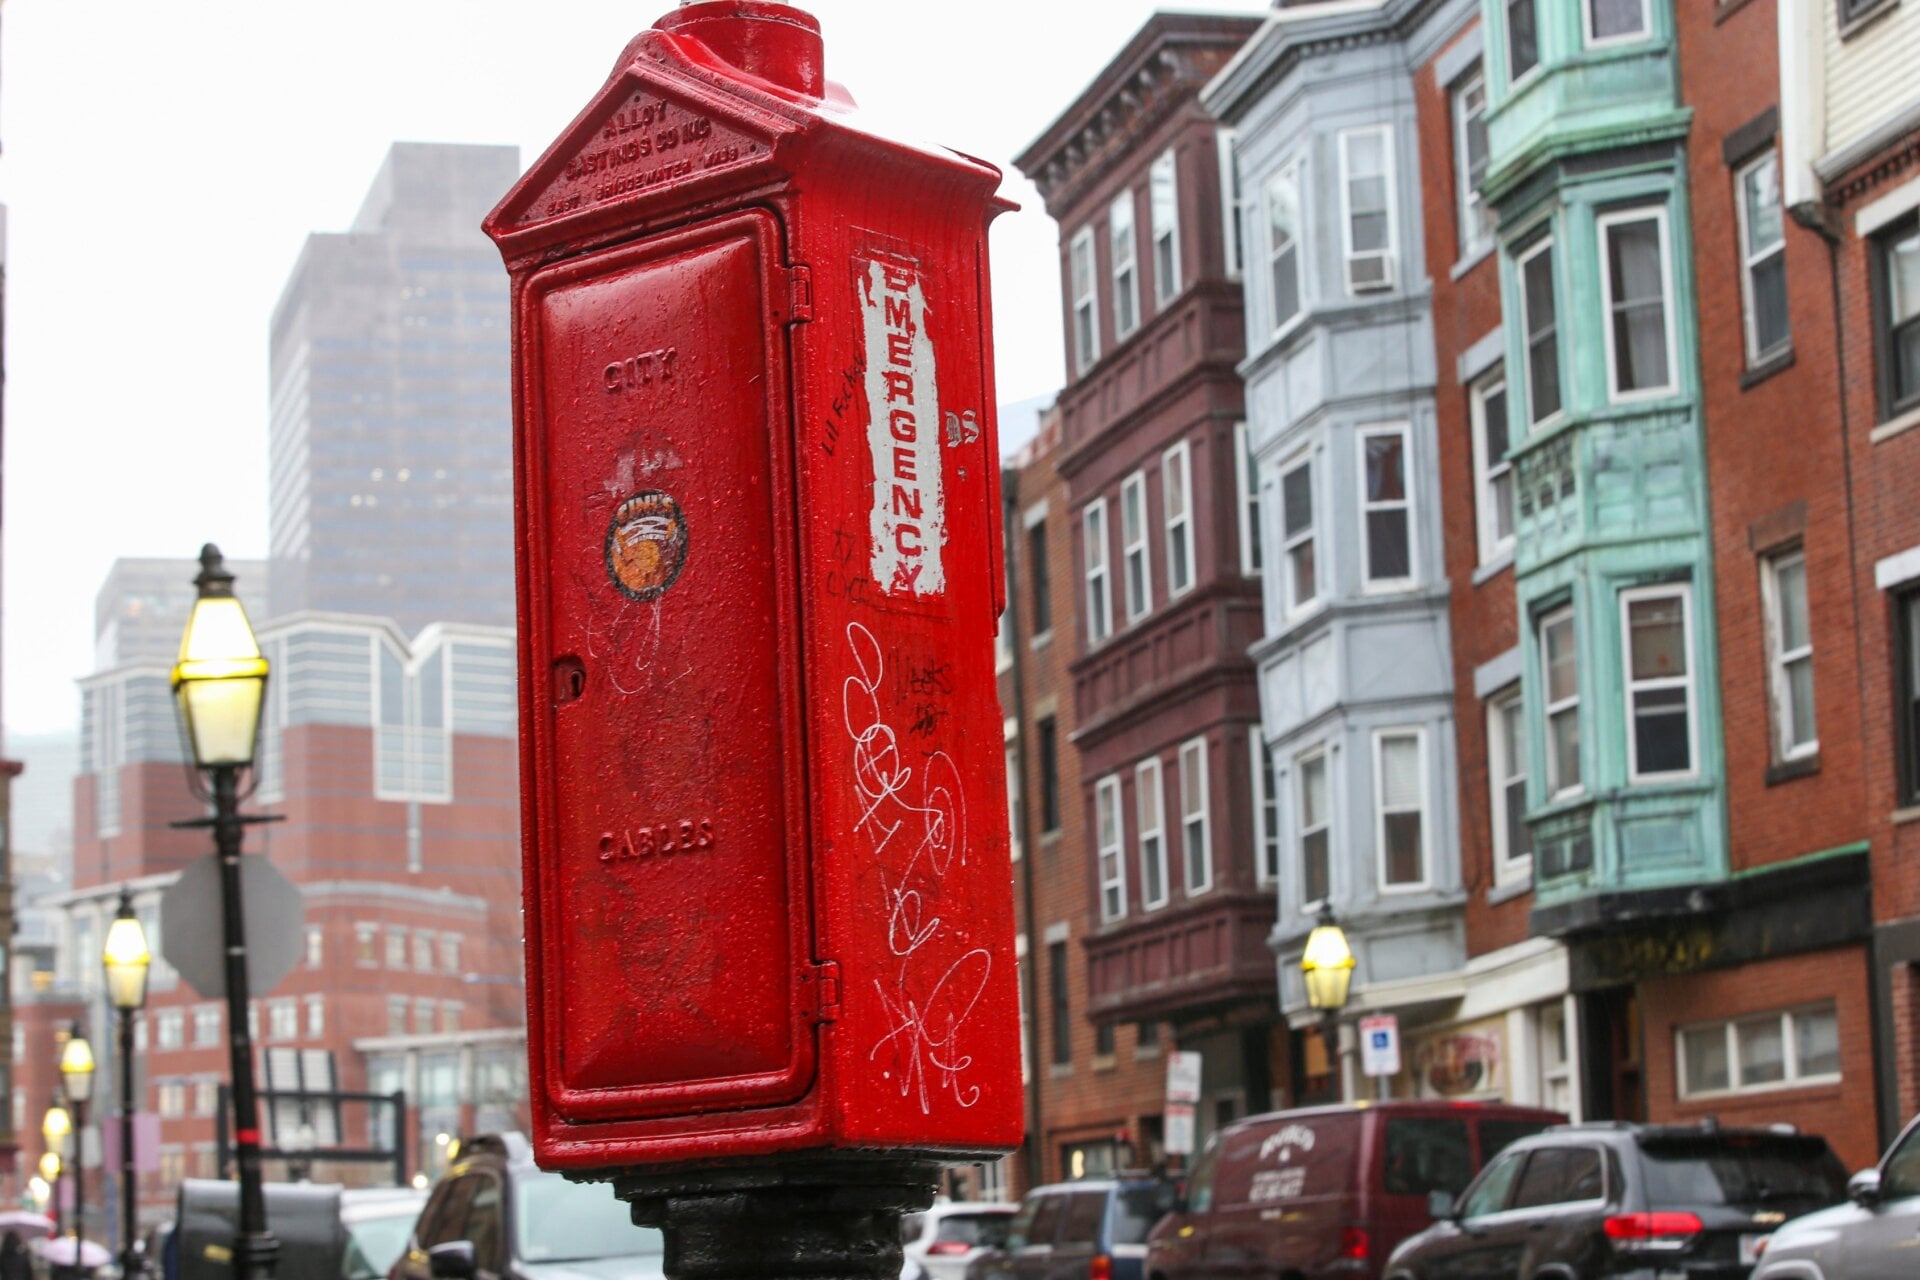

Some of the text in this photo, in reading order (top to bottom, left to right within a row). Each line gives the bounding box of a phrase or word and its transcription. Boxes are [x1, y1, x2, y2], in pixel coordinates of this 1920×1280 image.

[603, 100, 668, 139] ALLOY
[656, 127, 680, 153] CO
[603, 347, 678, 394] CITY
[600, 818, 715, 862] CABLES
